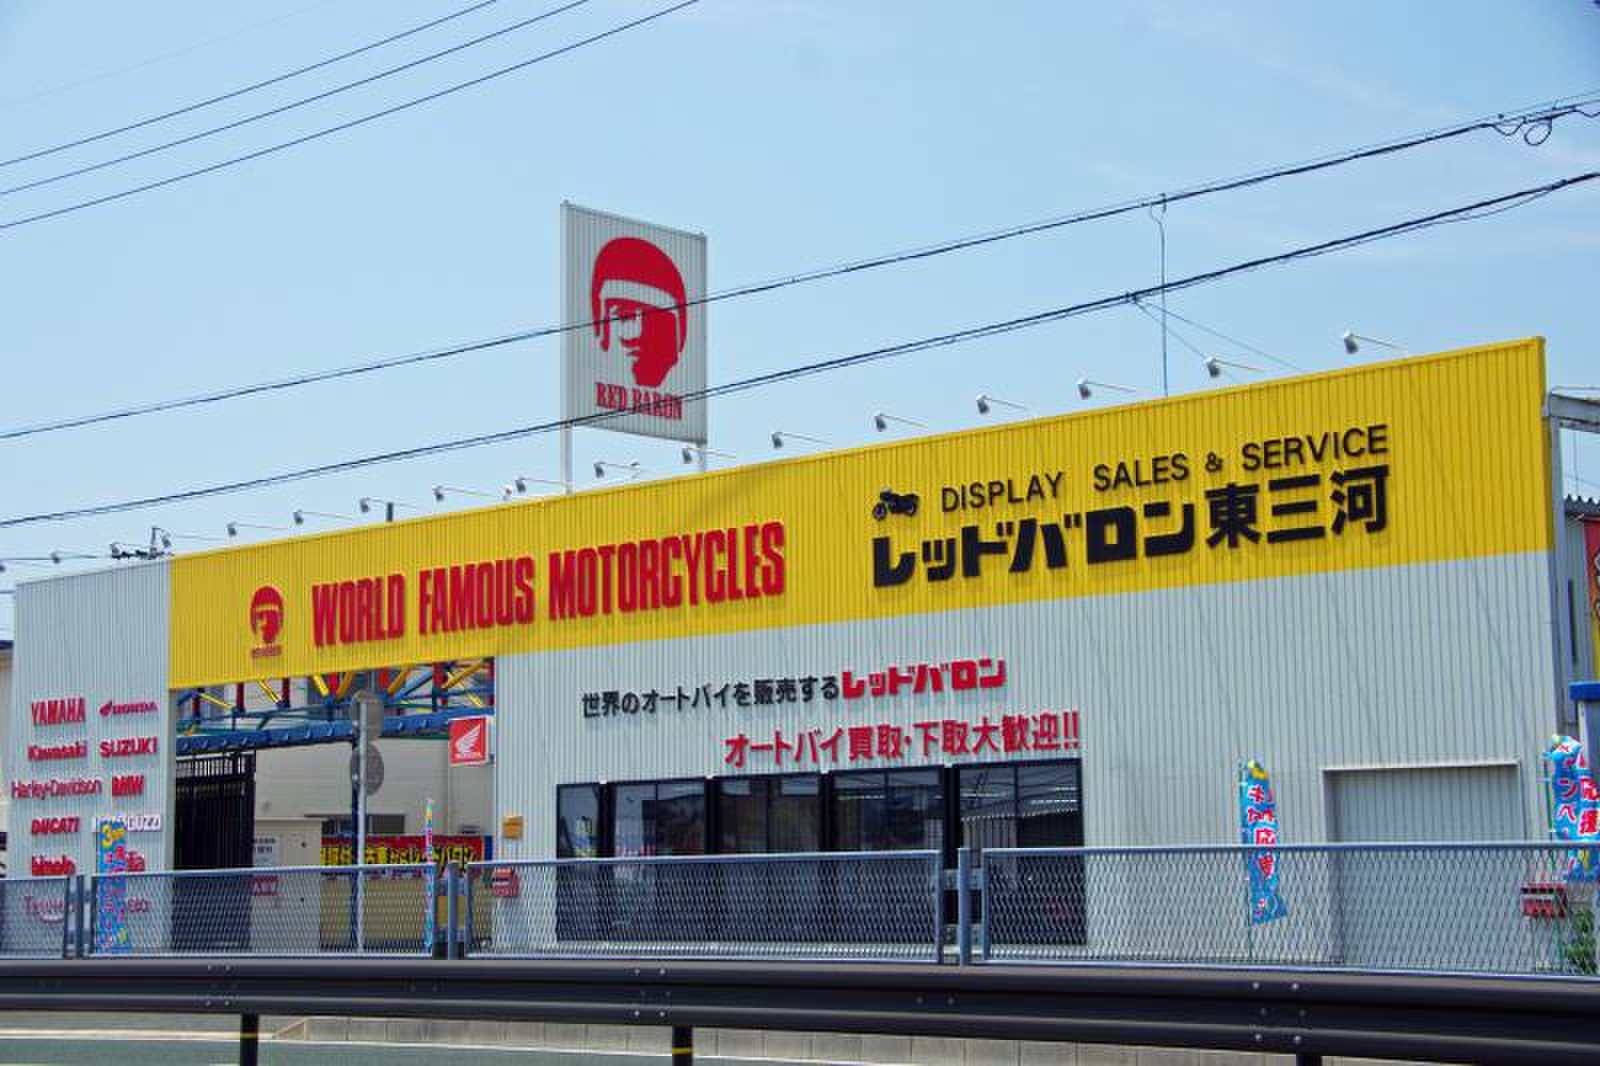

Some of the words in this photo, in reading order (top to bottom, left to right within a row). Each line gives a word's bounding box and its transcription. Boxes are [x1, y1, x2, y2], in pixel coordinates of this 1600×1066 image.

[596, 382, 628, 411] RED
[942, 471, 1063, 513] DISPLAY
[1093, 453, 1190, 492] SALES
[1205, 452, 1224, 474] &
[1242, 424, 1390, 475] SERVICE
[311, 573, 406, 648] WORLD
[418, 556, 536, 637] FAMOUS
[548, 521, 786, 622] MOTORCYCLES
[32, 698, 86, 726] YAMAHA
[100, 736, 158, 758] SUZUKI
[32, 817, 80, 835] DUCATI
